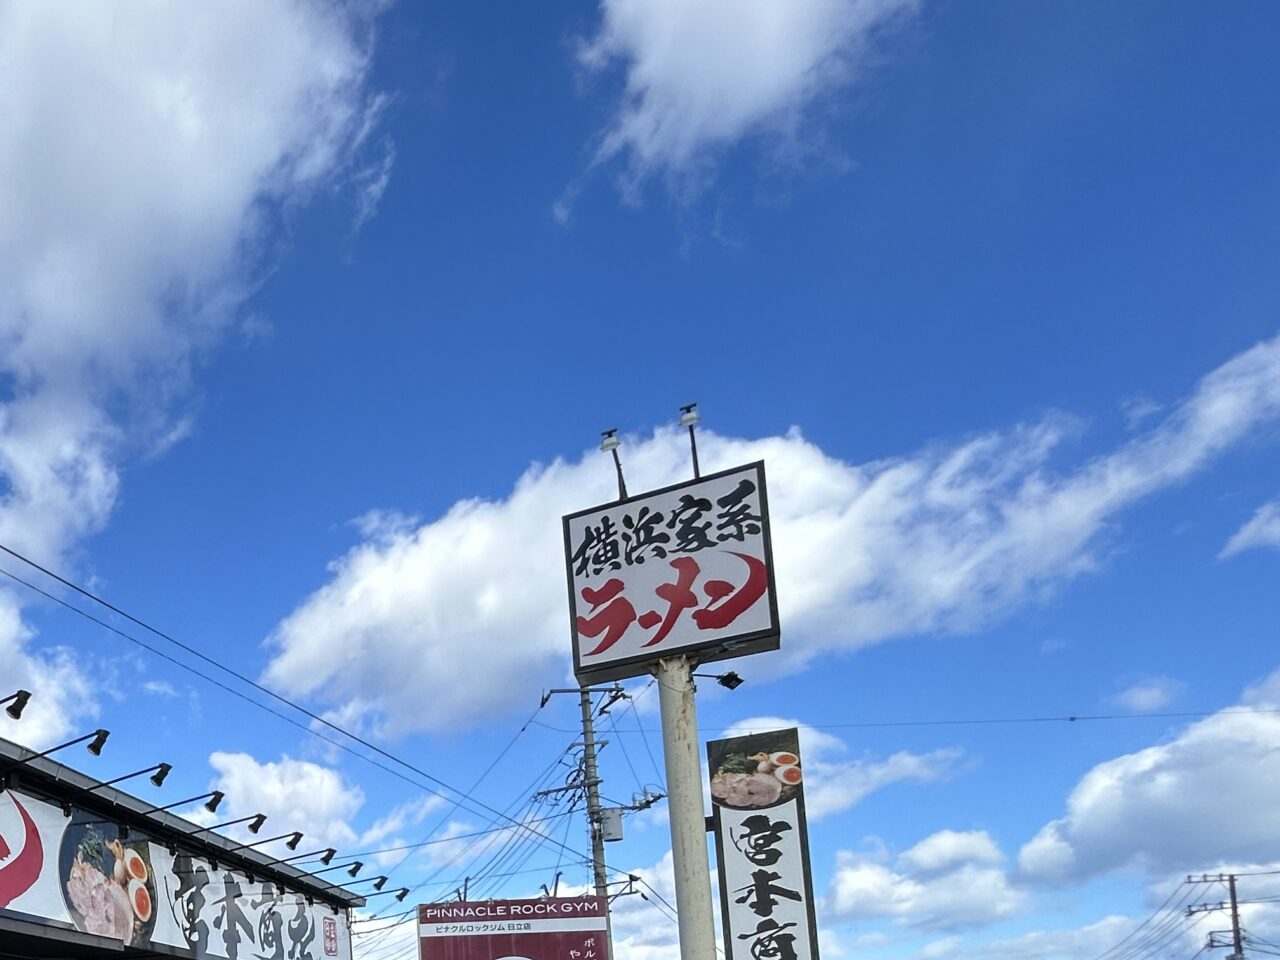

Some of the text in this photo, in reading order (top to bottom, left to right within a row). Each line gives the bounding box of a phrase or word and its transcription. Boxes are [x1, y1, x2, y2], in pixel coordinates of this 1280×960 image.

[572, 479, 762, 578] 横浜家系
[576, 551, 769, 657] ラーメン
[426, 901, 598, 918] PINNACLE ROCK GYM
[507, 922, 531, 931] 日立店
